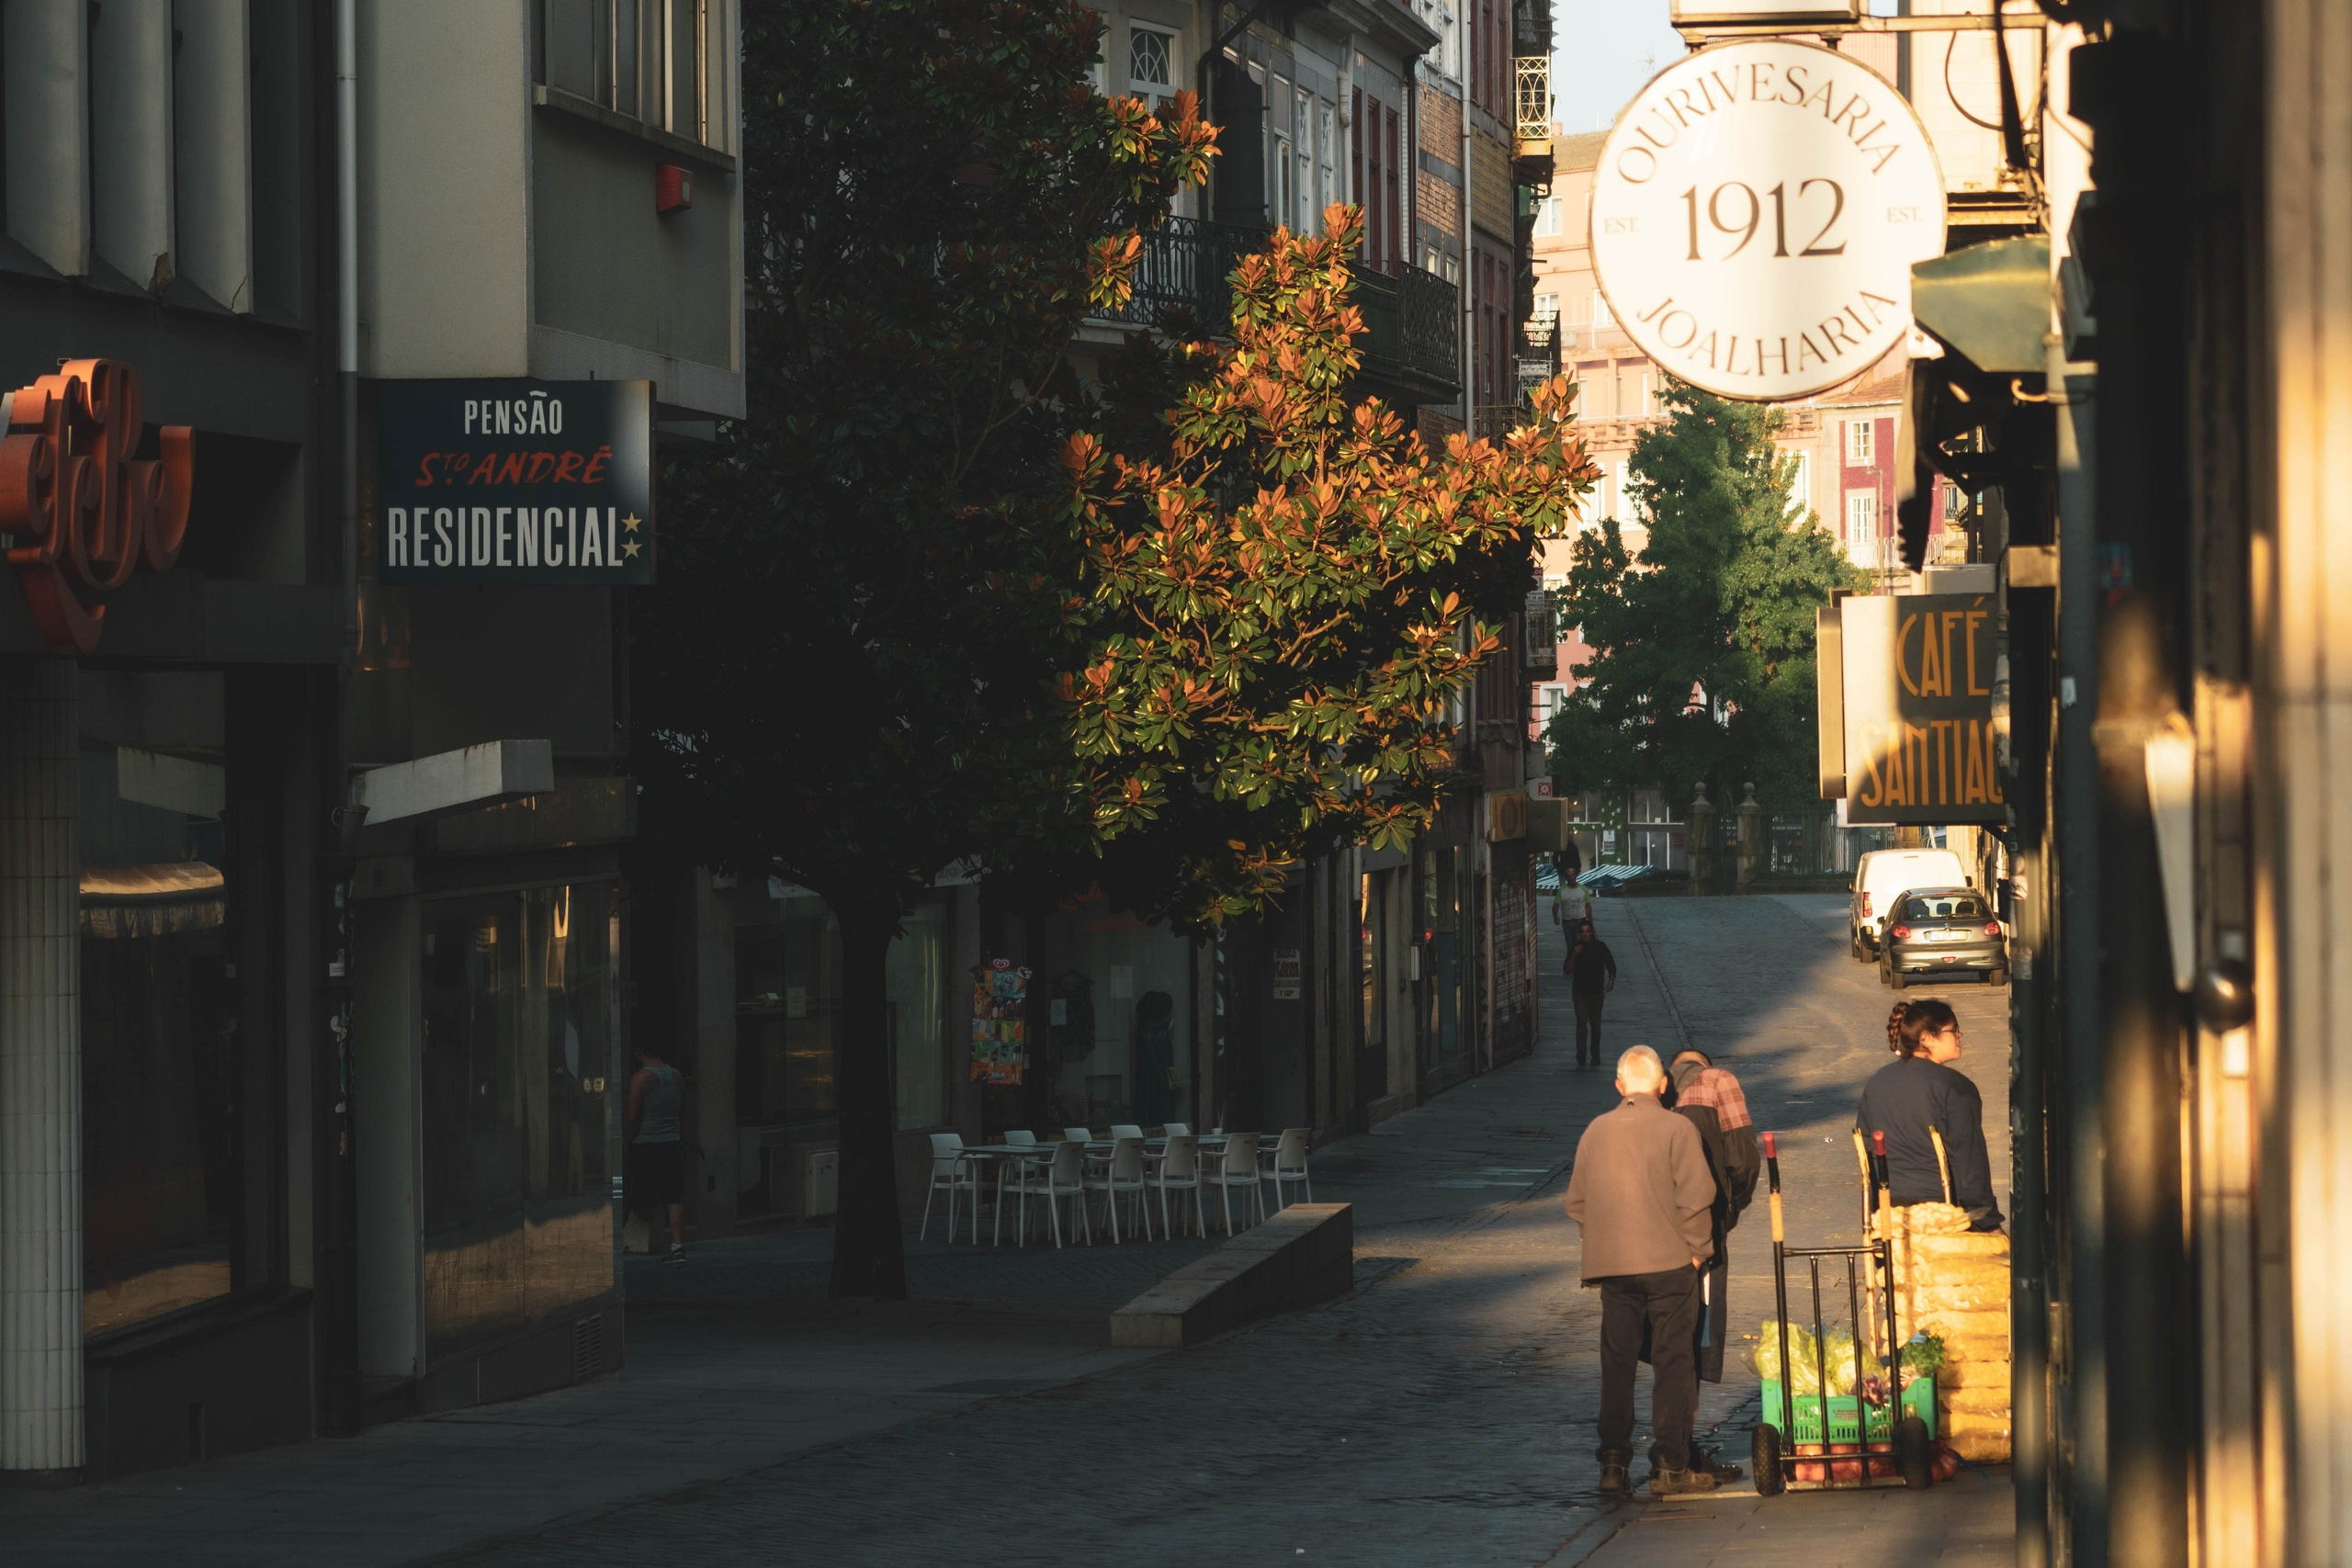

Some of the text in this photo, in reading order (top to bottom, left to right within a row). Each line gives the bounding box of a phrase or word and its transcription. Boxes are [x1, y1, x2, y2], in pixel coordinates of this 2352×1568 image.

[1617, 62, 1900, 184] OURIVESARIA
[1604, 178, 1922, 261] EST. 1912 EST.
[1636, 289, 1897, 377] JOALHARIA
[465, 390, 562, 434] PENSÃO
[468, 446, 613, 485] ANDRÉ
[388, 507, 624, 567] RESIDENCIAL
[1896, 597, 1989, 697] CAFÉ
